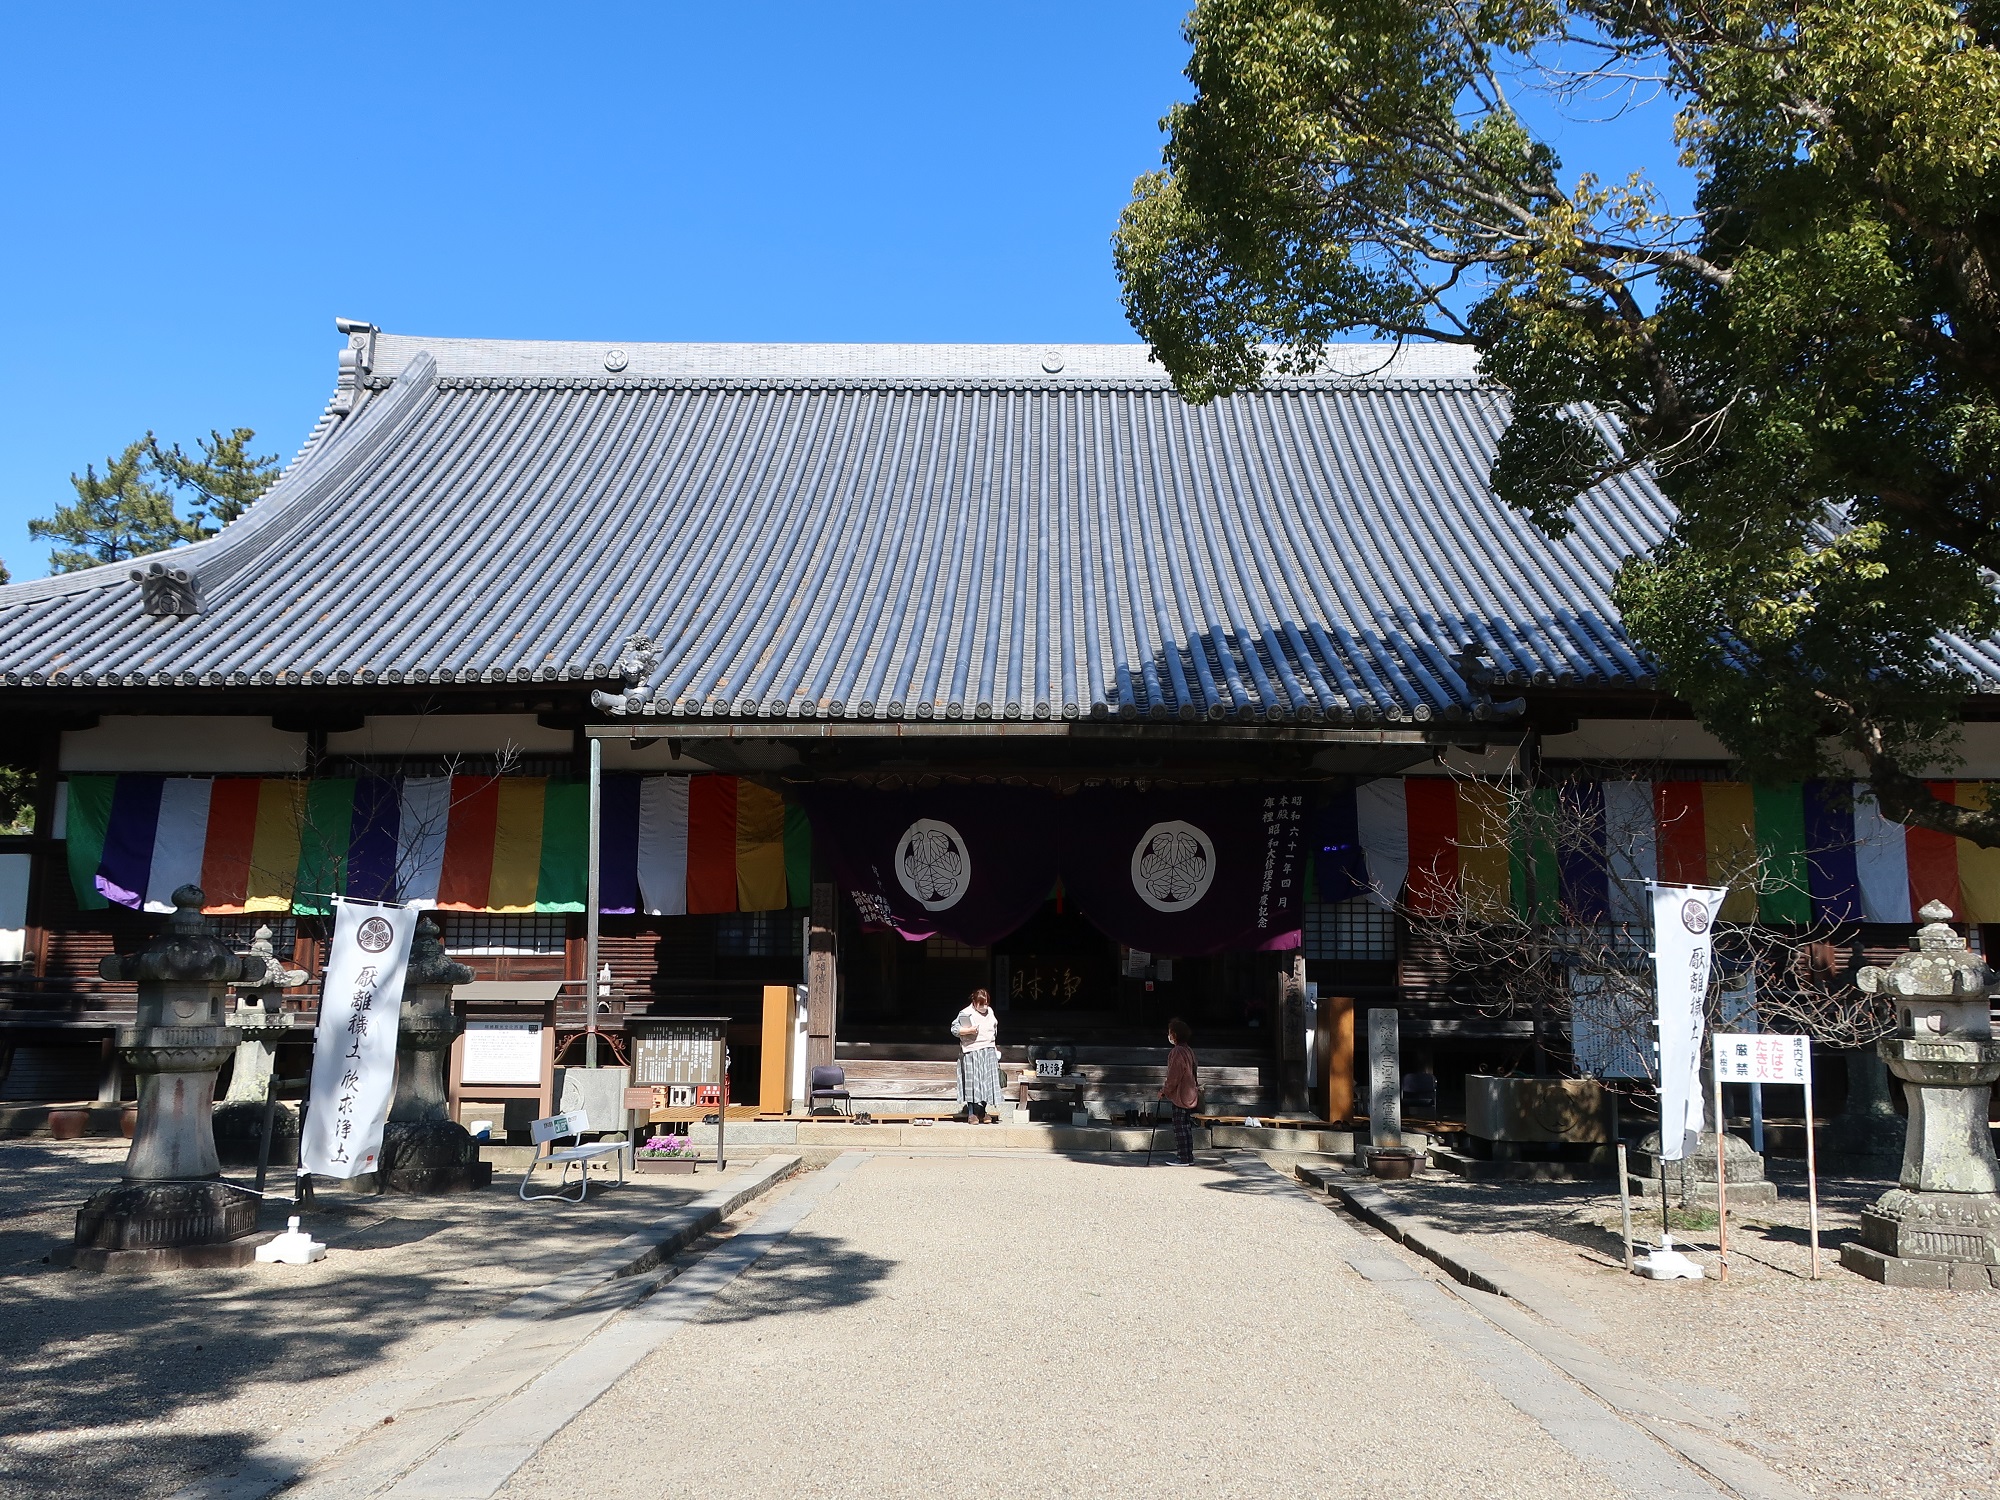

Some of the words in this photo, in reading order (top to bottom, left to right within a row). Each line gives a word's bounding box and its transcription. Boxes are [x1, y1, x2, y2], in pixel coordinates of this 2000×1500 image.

[1278, 796, 1302, 909] 昭和六十一年四月
[1736, 1044, 1748, 1076] 厳禁
[1756, 1039, 1768, 1078] たき火
[1771, 1040, 1784, 1079] たばこ
